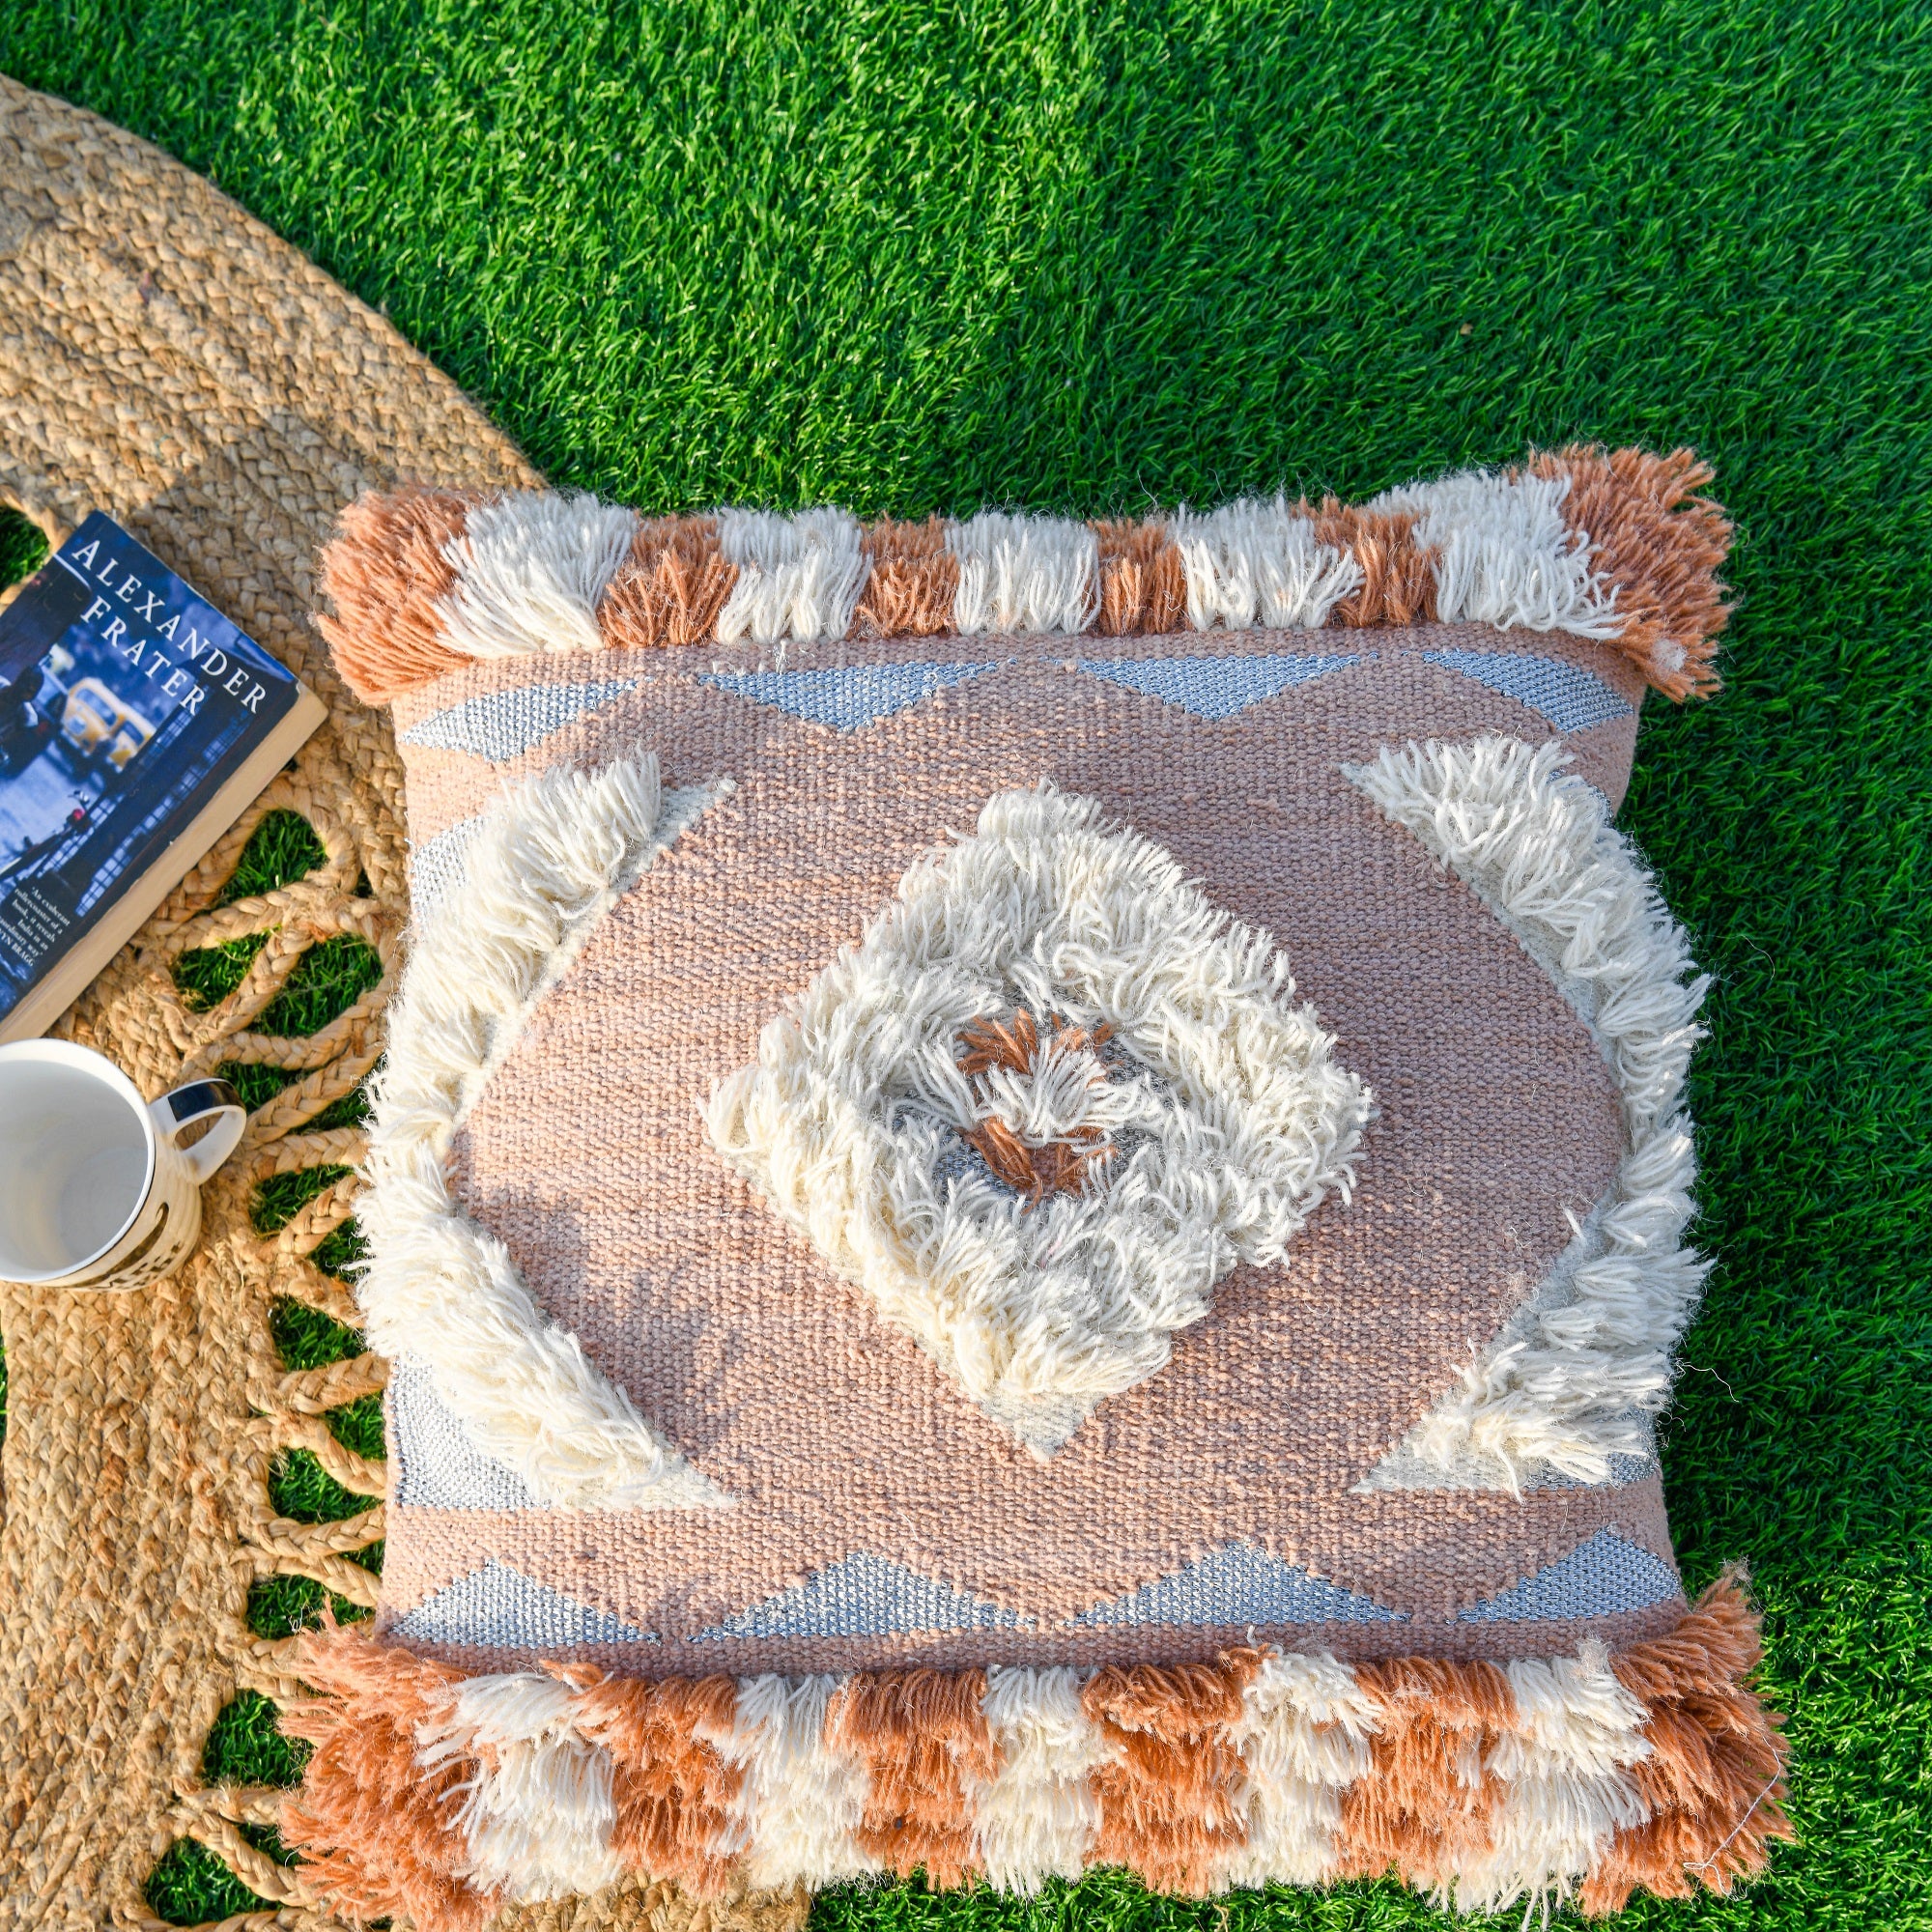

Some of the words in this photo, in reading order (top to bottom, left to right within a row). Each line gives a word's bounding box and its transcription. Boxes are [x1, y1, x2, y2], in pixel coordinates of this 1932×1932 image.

[71, 539, 267, 714] ALEXANDER
[80, 595, 205, 715] FRATER
[12, 898, 29, 920] book,
[36, 923, 55, 943] reveals
[14, 888, 51, 923] rollercoaster
[50, 921, 60, 929] of
[42, 899, 71, 926] exuberant
[11, 942, 35, 967] BRAGG
[17, 919, 34, 936] India
[40, 942, 48, 951] an
